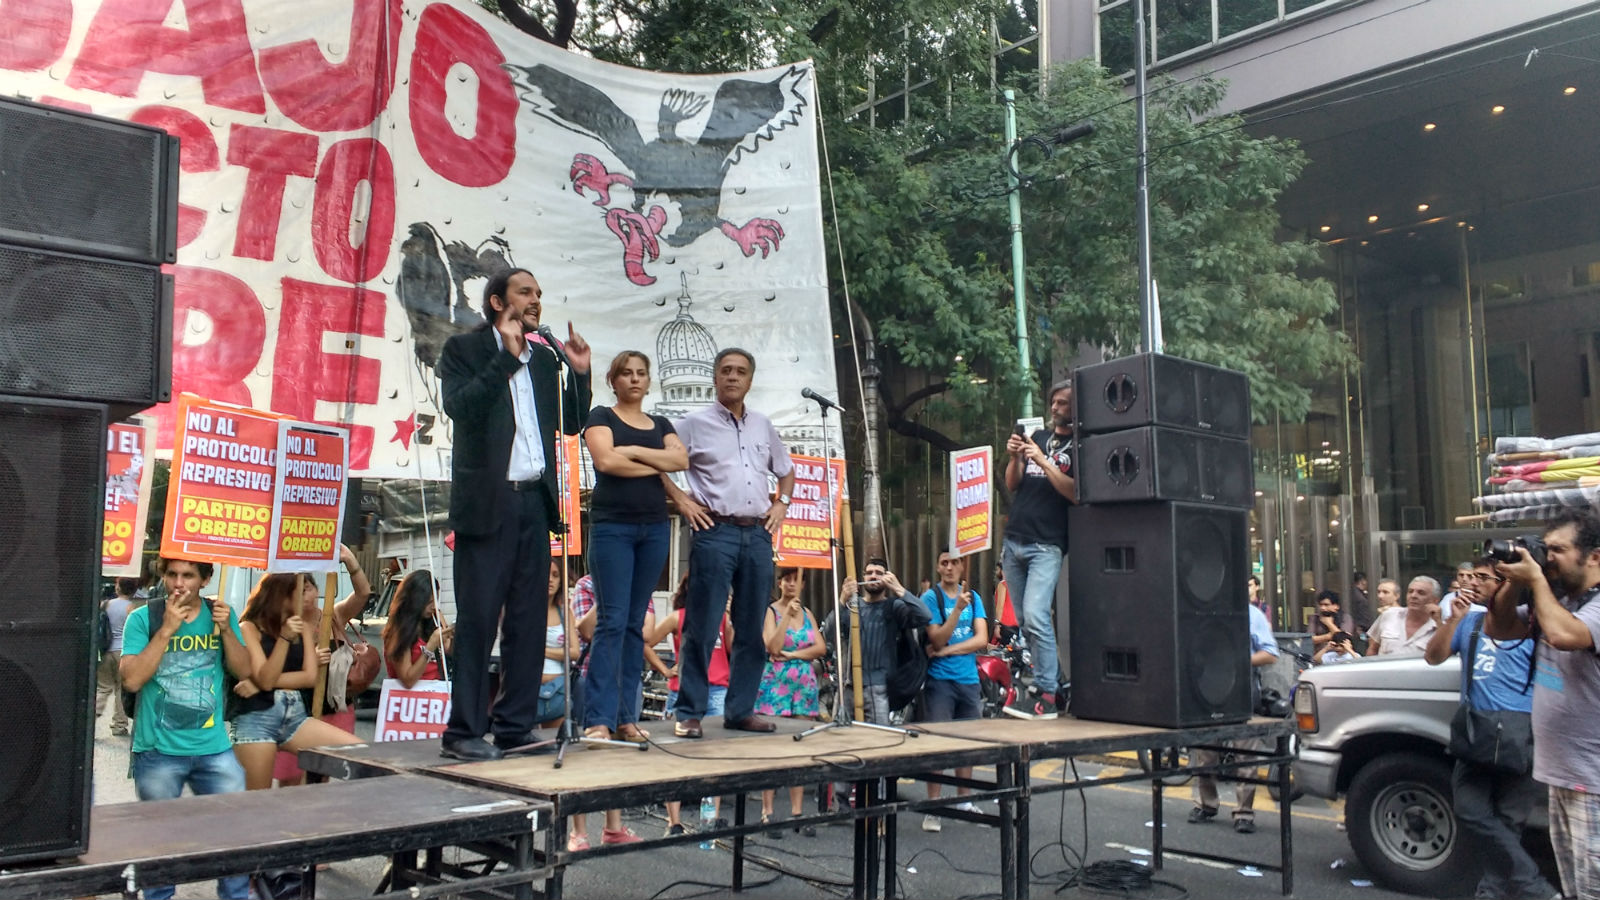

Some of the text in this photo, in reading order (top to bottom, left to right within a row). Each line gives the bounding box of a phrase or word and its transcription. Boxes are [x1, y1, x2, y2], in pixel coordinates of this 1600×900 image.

[188, 412, 236, 437] NO AL
[119, 431, 141, 455] EL
[185, 436, 277, 467] PROTOCOLO
[287, 435, 317, 456] NO AL
[182, 461, 272, 491] REPRESIVO
[285, 459, 342, 482] PROTOCOLO
[956, 457, 985, 484] FUERA
[283, 484, 338, 506] REPRESIVO
[956, 482, 988, 510] OBAMA
[182, 498, 271, 523] PARTIDO
[184, 516, 266, 540] OBRERO
[281, 519, 335, 536] PARTIDO
[782, 524, 831, 539] PARTIDO
[281, 536, 332, 553] OBRERO
[782, 537, 830, 551] OBRERO
[1473, 653, 1496, 672] 72
